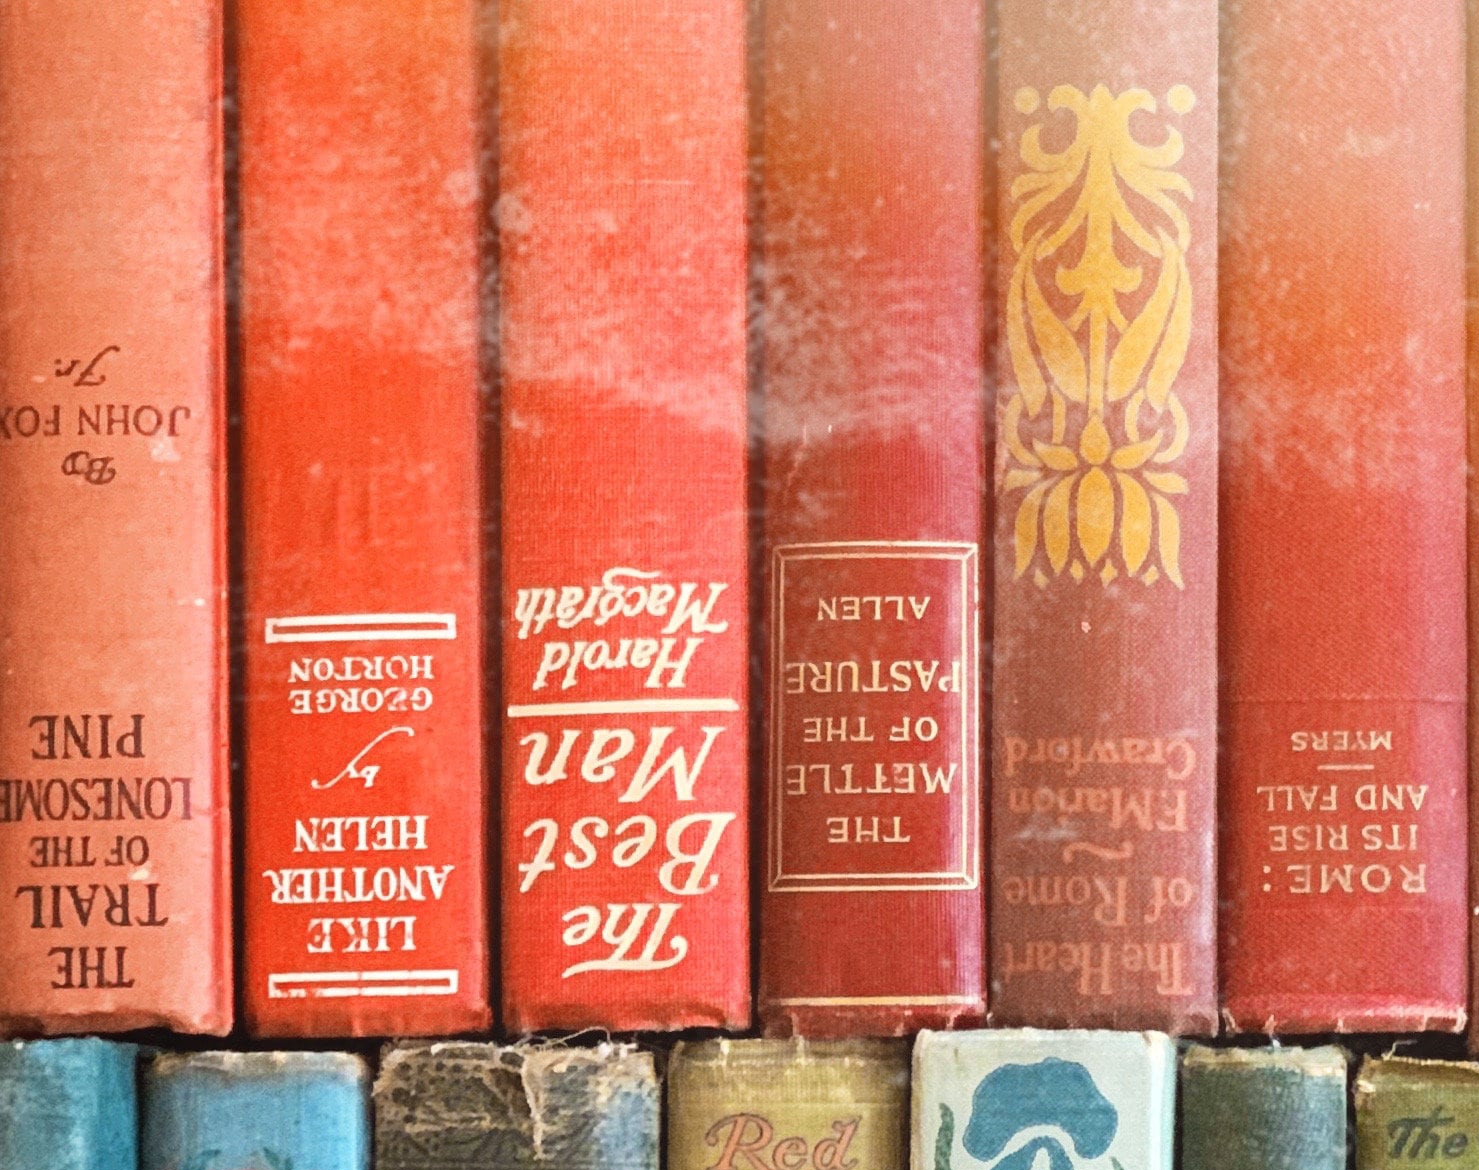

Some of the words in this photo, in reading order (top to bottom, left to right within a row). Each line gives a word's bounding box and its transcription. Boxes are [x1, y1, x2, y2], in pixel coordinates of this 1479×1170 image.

[54, 345, 121, 388] Jr.
[77, 404, 192, 437] JOHN
[513, 566, 729, 640] Macgrath
[817, 595, 931, 621] ALLEN
[288, 654, 435, 684] HORTON
[532, 636, 704, 690] Harold
[786, 660, 962, 695] PASTURE
[289, 686, 434, 715] GEORGE
[29, 713, 147, 761] PINE
[803, 716, 875, 743] THE
[888, 716, 940, 742] OF
[1290, 730, 1393, 753] MYERS
[311, 726, 415, 790] by
[519, 725, 728, 803] Man
[1004, 735, 1197, 781] Crawford
[786, 762, 958, 796] METTLE
[1256, 785, 1337, 812] FALL
[1355, 784, 1429, 811] AND
[293, 814, 430, 853] HELEN
[826, 816, 912, 844] THE
[1269, 824, 1348, 853] RISE
[1361, 823, 1418, 850] ITS
[29, 835, 97, 868] THE
[105, 834, 151, 867] OF
[518, 811, 737, 896] Best
[262, 864, 456, 905] ANOTHER
[1004, 875, 1127, 927] Rome
[1145, 875, 1197, 926] of
[15, 881, 169, 929] TRAIL
[306, 915, 417, 954] LIKE
[561, 902, 689, 979] The
[47, 945, 136, 990] THE
[1004, 941, 1113, 996] Heart
[1123, 941, 1195, 996] The
[1387, 1106, 1469, 1160] The
